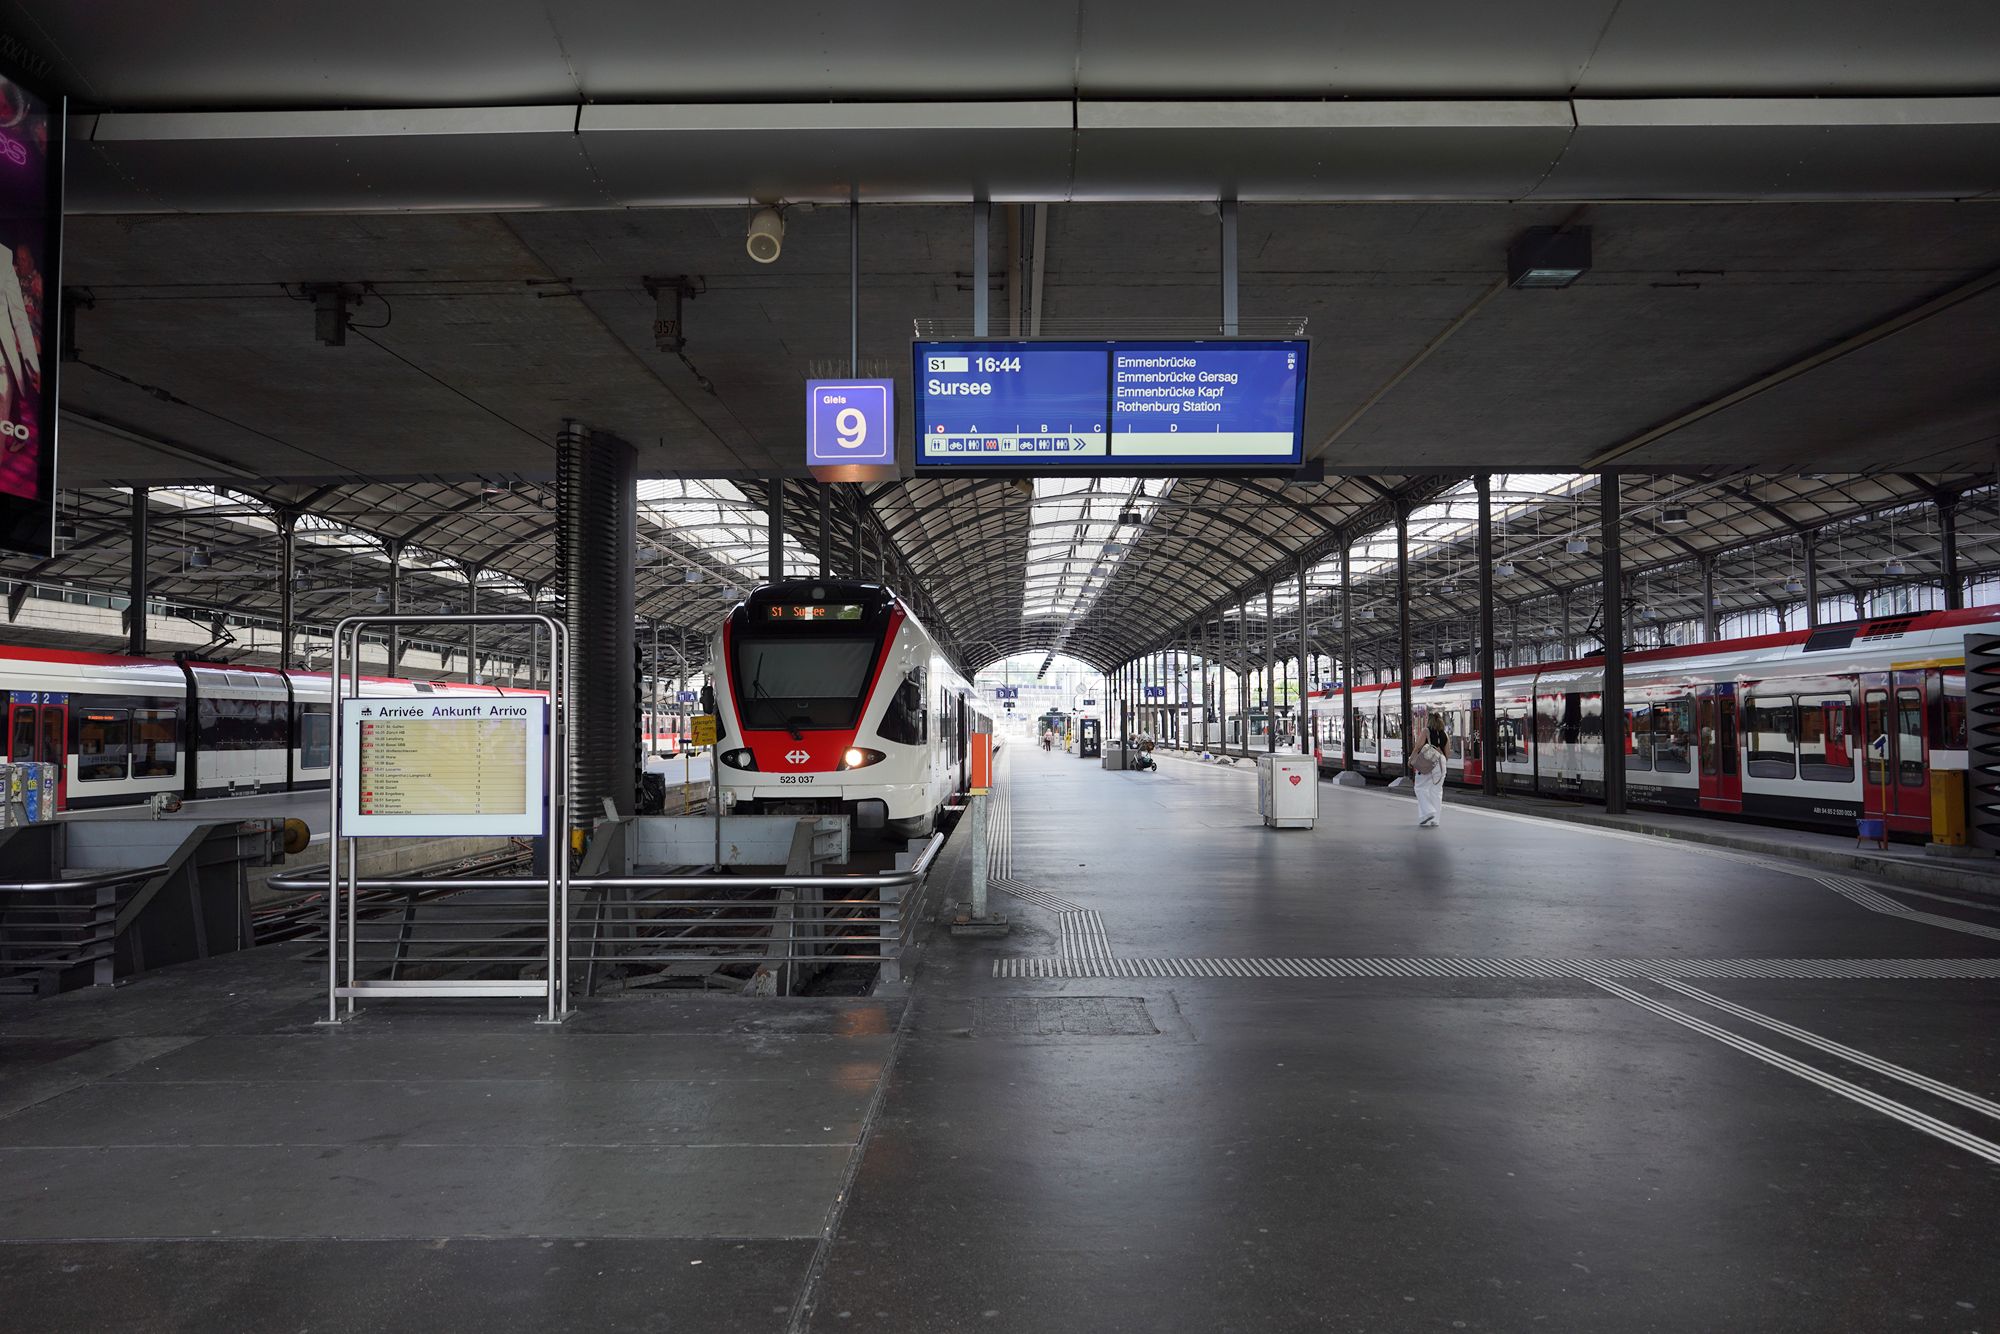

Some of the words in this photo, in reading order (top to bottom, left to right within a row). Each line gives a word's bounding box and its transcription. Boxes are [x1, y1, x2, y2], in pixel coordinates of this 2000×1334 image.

[930, 359, 947, 371] S1
[975, 357, 1022, 373] 16:44
[1117, 356, 1196, 368] Emmenbrücke
[1117, 371, 1196, 383] Emmenbrücke
[1198, 371, 1238, 385] Gersag
[928, 379, 992, 396] Sursee
[1117, 386, 1195, 398] Emmenbrücke
[1198, 386, 1225, 399] Kapf
[823, 395, 847, 404] Gleis
[1116, 401, 1180, 414] Rothenburg
[1182, 401, 1221, 412] Station
[835, 407, 867, 449] 9
[970, 424, 978, 433] A
[1041, 424, 1048, 433] B
[1093, 424, 1101, 433] C
[1170, 424, 1178, 433] D
[771, 606, 782, 617] S1
[1881, 672, 1888, 686] 2
[1895, 671, 1900, 685] 1
[31, 692, 38, 704] 2
[43, 693, 50, 704] 2
[689, 693, 695, 701] A
[1009, 690, 1015, 698] A
[379, 705, 424, 717] Arrivée
[432, 705, 481, 717] Ankunft
[489, 705, 527, 716] Arrivo
[780, 775, 796, 784] 523
[798, 775, 815, 784] 037
